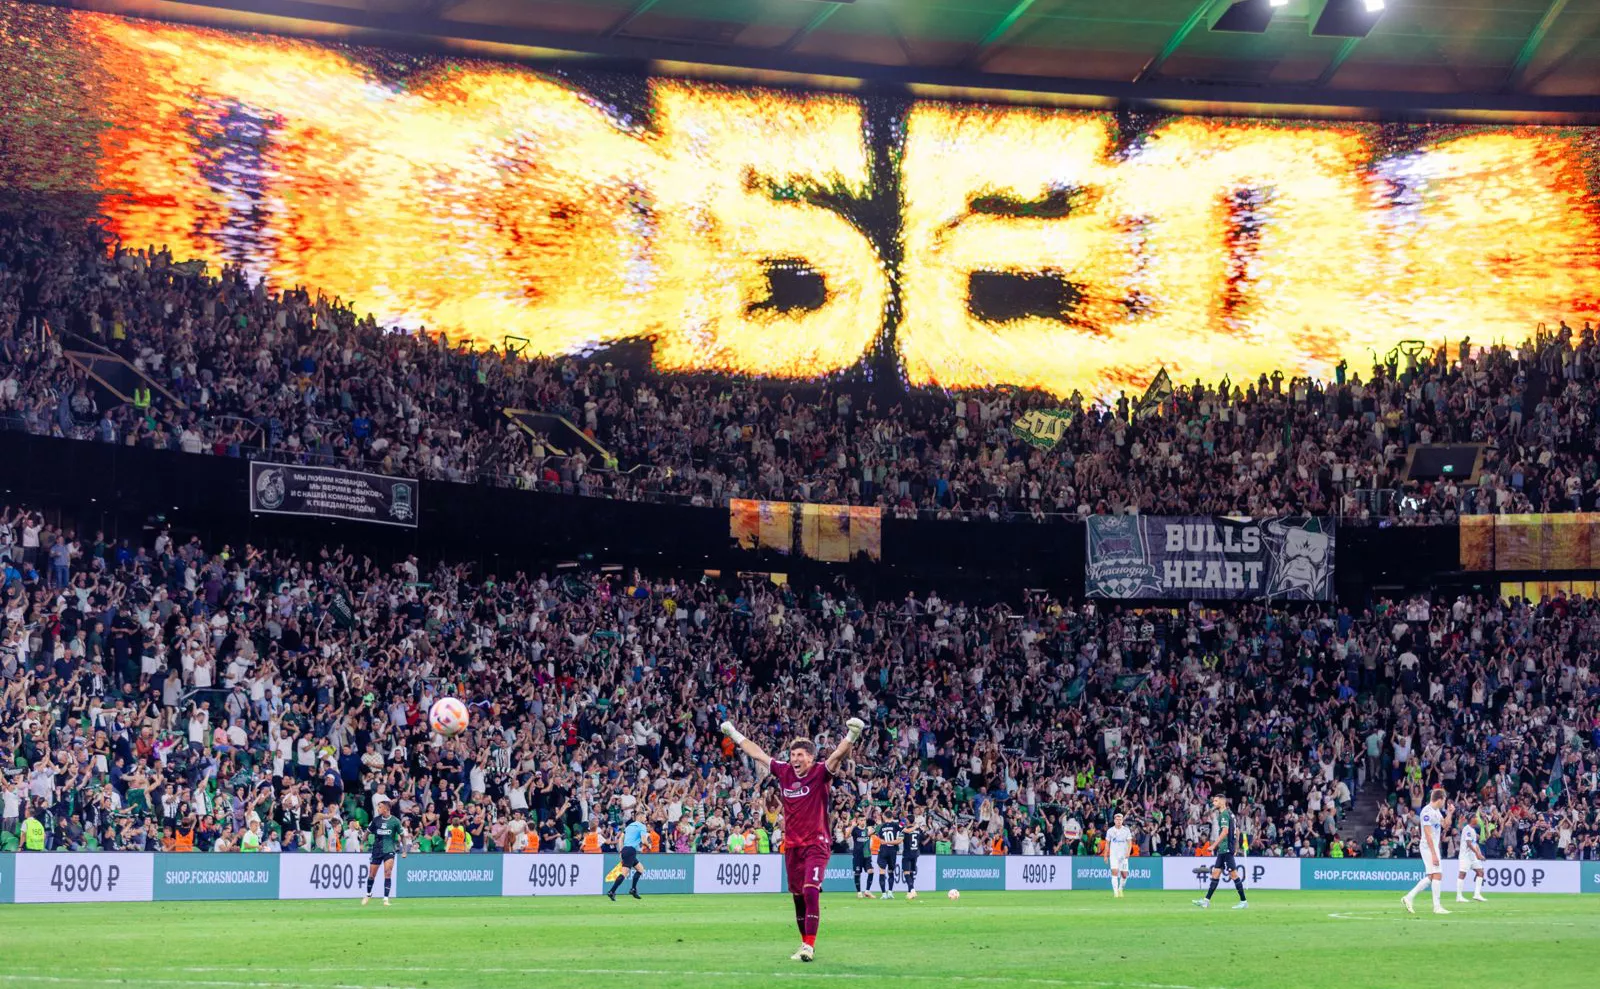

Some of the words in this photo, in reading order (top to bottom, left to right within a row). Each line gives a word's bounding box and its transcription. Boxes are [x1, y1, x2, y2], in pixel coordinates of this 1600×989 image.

[307, 474, 334, 482] ЛЮБИМ
[1166, 524, 1260, 553] BULLS
[1162, 560, 1263, 589] HEART
[883, 831, 894, 846] 10
[912, 834, 918, 847] 5
[51, 864, 102, 892] 4990
[166, 870, 269, 885] SHOP.FCKRASNODAR.RU
[309, 864, 353, 890] 4990
[407, 869, 494, 882] SHOP.FCKRASNODAR.RU
[529, 864, 566, 887] 4990
[717, 863, 749, 885] 4990
[812, 867, 819, 881] 1
[1023, 864, 1047, 883] 4990
